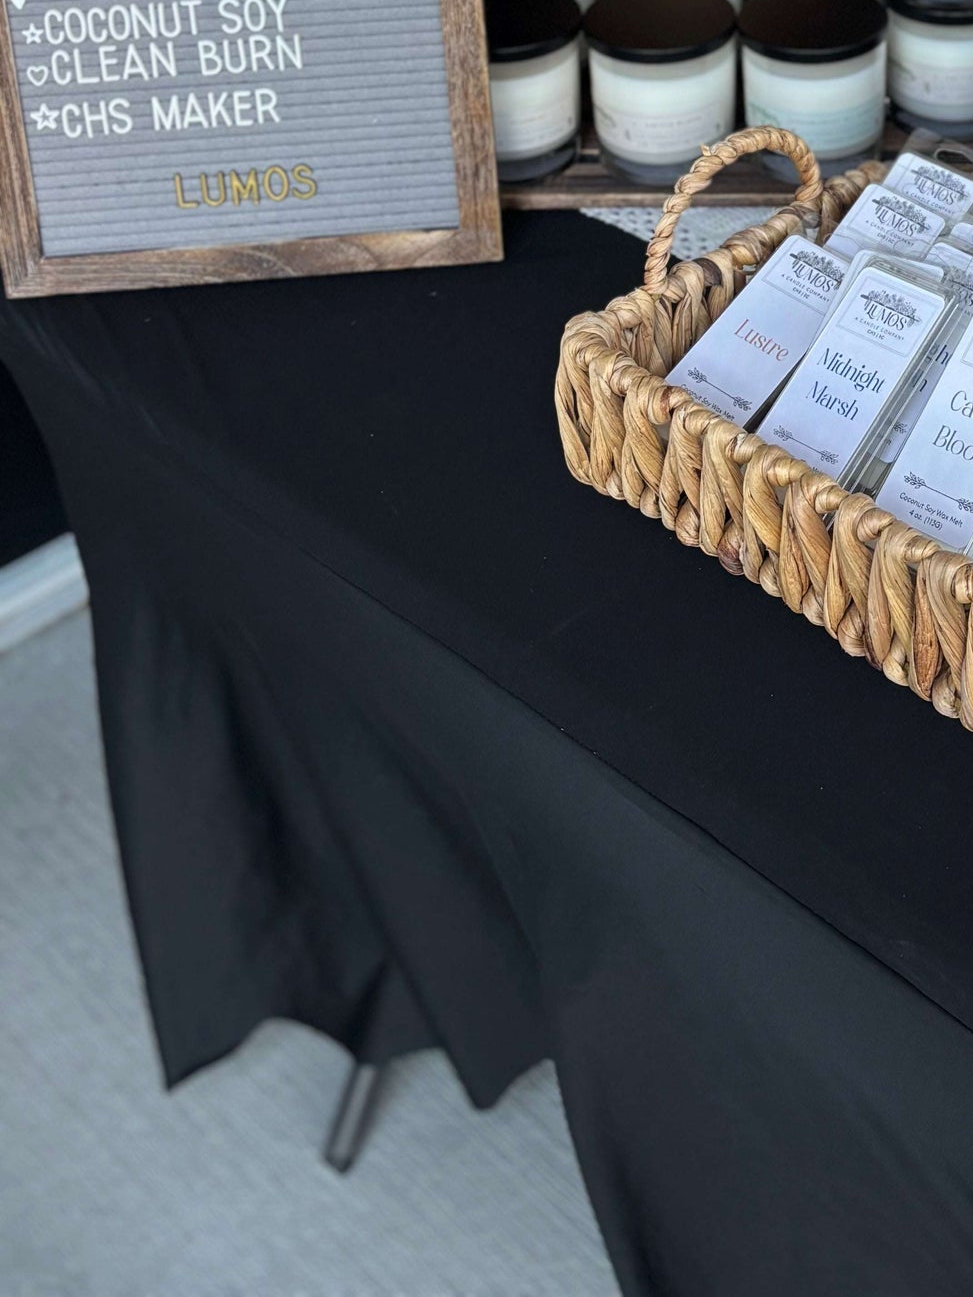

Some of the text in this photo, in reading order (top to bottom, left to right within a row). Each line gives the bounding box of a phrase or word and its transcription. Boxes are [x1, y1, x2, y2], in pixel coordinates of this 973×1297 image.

[43, 0, 202, 45] COCONUT
[50, 35, 303, 86] CLEAN BURN
[61, 88, 280, 139] CHS MAKER
[174, 164, 318, 209] LUMOS
[917, 178, 955, 205] LUMOS
[877, 205, 916, 237] LUMOS
[793, 261, 834, 293] LUMOS
[865, 302, 907, 331] LUMOS
[734, 319, 789, 362] Lustre
[817, 348, 886, 394] Midnight
[806, 381, 859, 420] Marsh
[899, 492, 962, 528] Coconut Soy Wax Melt
